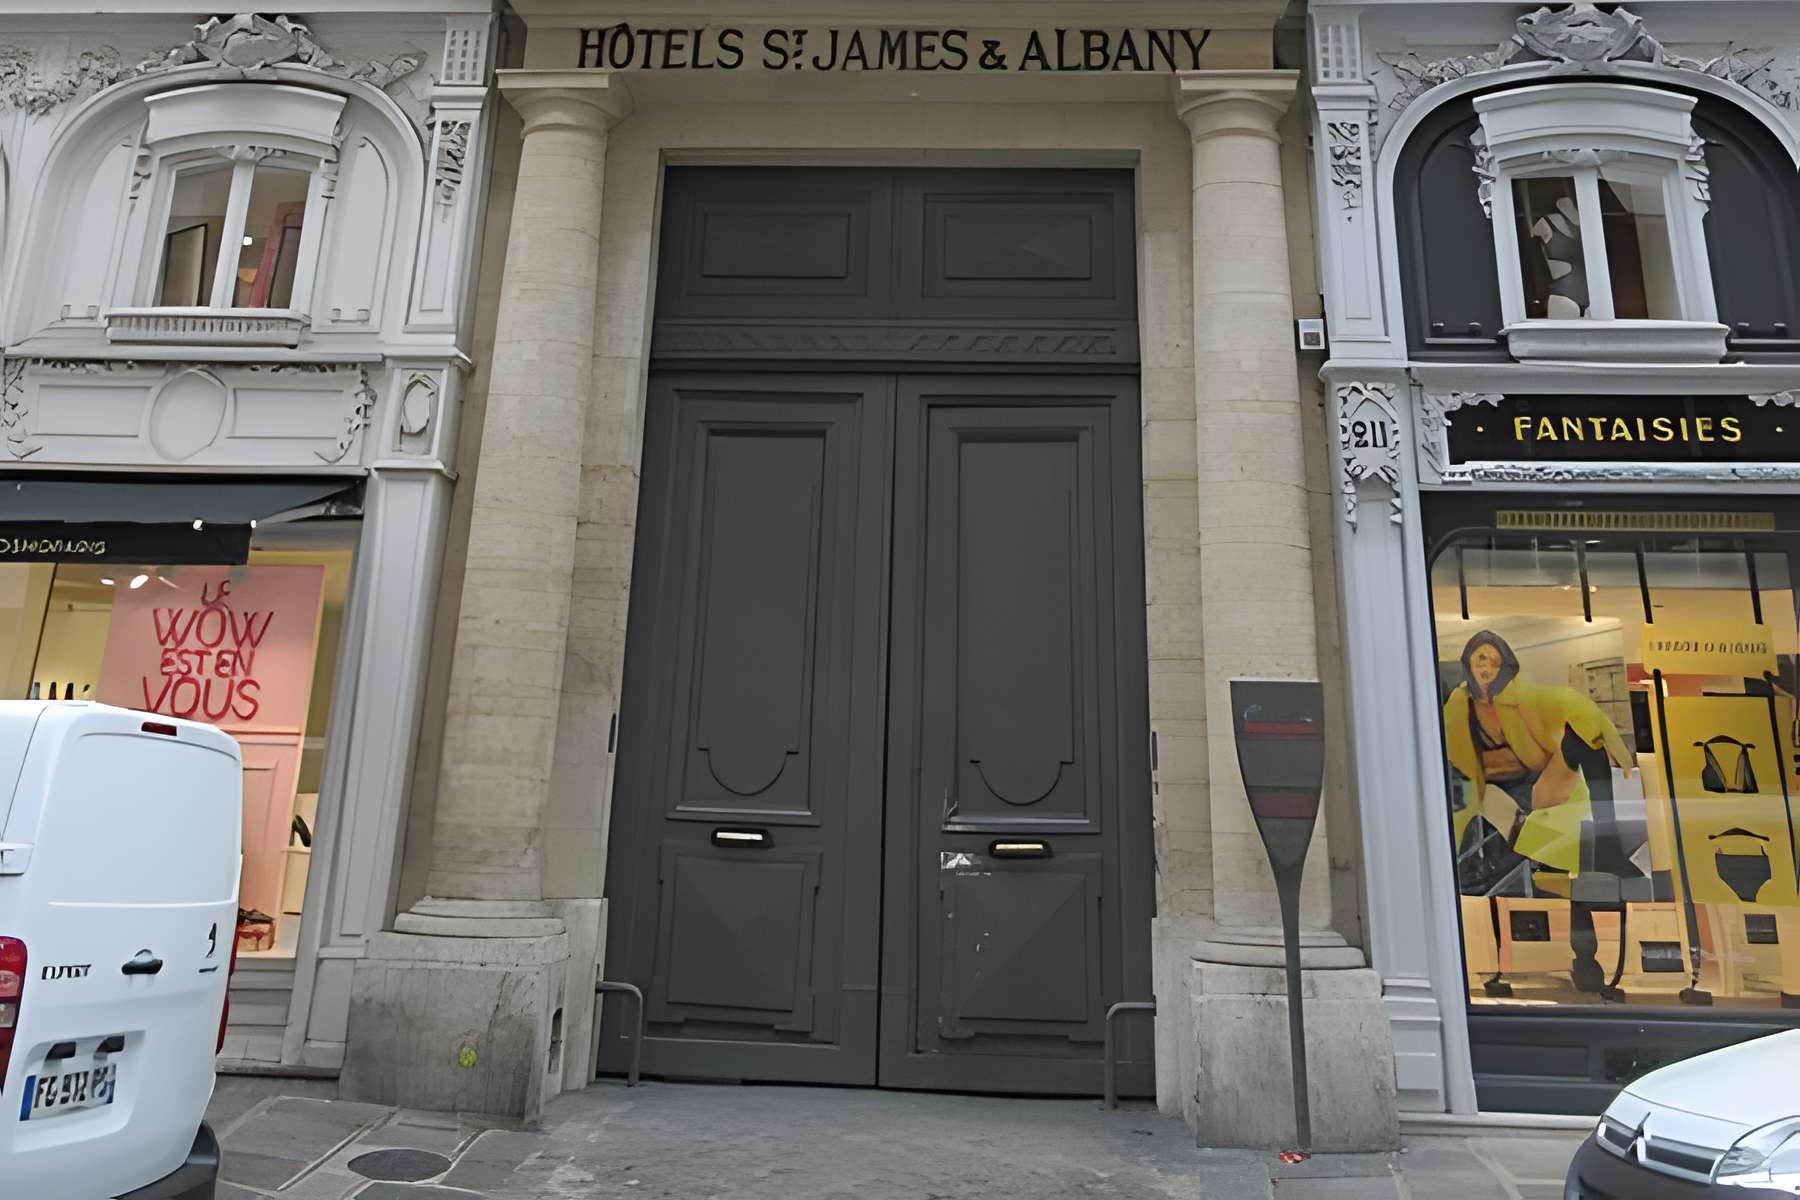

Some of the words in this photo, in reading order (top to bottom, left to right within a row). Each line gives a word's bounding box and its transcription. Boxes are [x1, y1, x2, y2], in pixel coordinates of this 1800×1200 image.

[812, 28, 969, 71] JAMES
[978, 39, 1009, 70] &
[1018, 27, 1212, 72] ALBANY
[1513, 415, 1742, 443] FANTAISIES
[152, 607, 274, 648] WOW
[160, 647, 212, 676] EST
[214, 648, 256, 678] EN
[142, 675, 261, 721] VOUS
